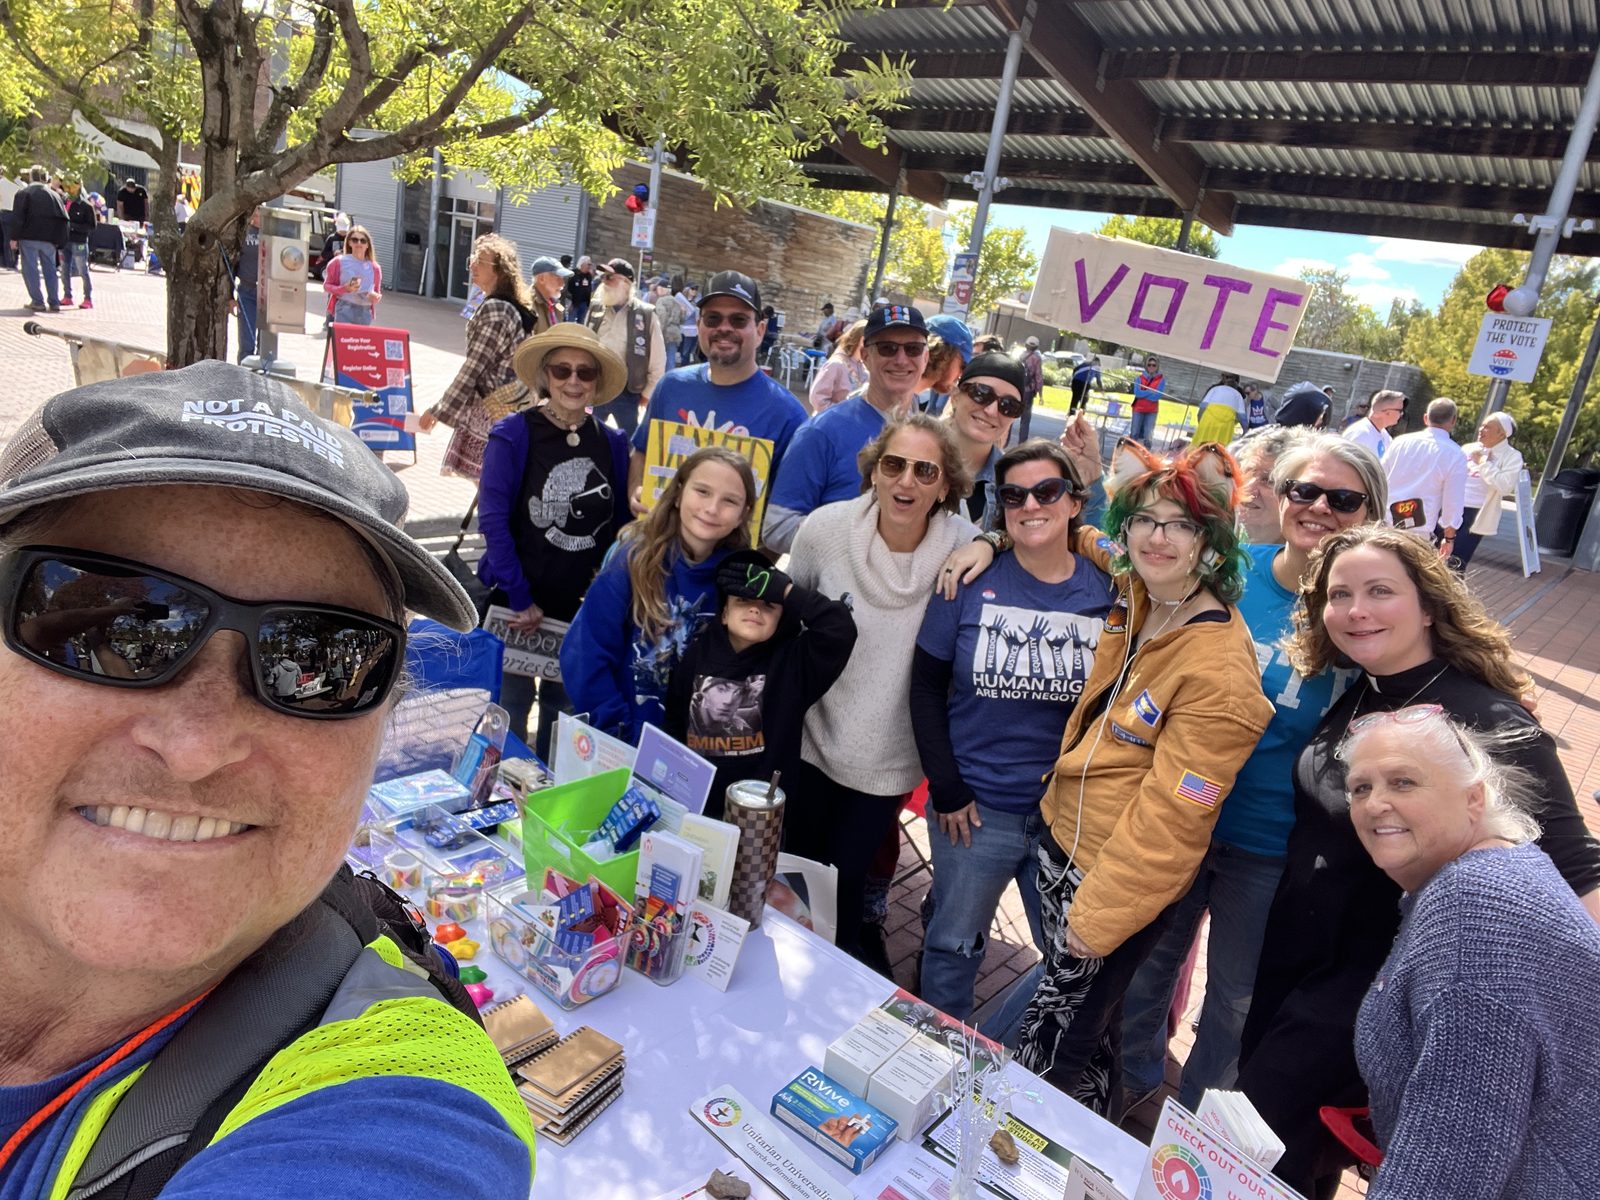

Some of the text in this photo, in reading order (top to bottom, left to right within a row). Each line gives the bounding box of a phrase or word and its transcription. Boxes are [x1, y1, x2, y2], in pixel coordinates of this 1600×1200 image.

[1074, 257, 1304, 358] VOTE
[1486, 331, 1538, 348] THE VOTE
[1492, 318, 1540, 334] PROTECT
[1492, 358, 1514, 367] VOTE
[183, 399, 245, 414] NOT
[252, 401, 274, 416] A
[281, 408, 342, 450] PAID
[181, 412, 345, 470] PROTESTER
[986, 630, 997, 668] FREEDOM
[1005, 644, 1019, 673] JUSTICE
[1029, 636, 1041, 673] EQUALITY
[1052, 646, 1065, 676] DIGNITY
[1074, 648, 1082, 669] LOVE
[503, 656, 541, 674] ories
[972, 673, 1084, 693] HUMAN RIG
[976, 687, 1080, 703] ARE NOT NEGOT
[687, 730, 765, 751] EMINEM
[1008, 1120, 1046, 1147] RIGHTS AS
[1008, 1127, 1041, 1150] STUDENT
[742, 1123, 833, 1200] Unitarian Universalis
[746, 1142, 811, 1199] Church of Birmingham
[1167, 1117, 1267, 1200] CHECK OUT OUR
